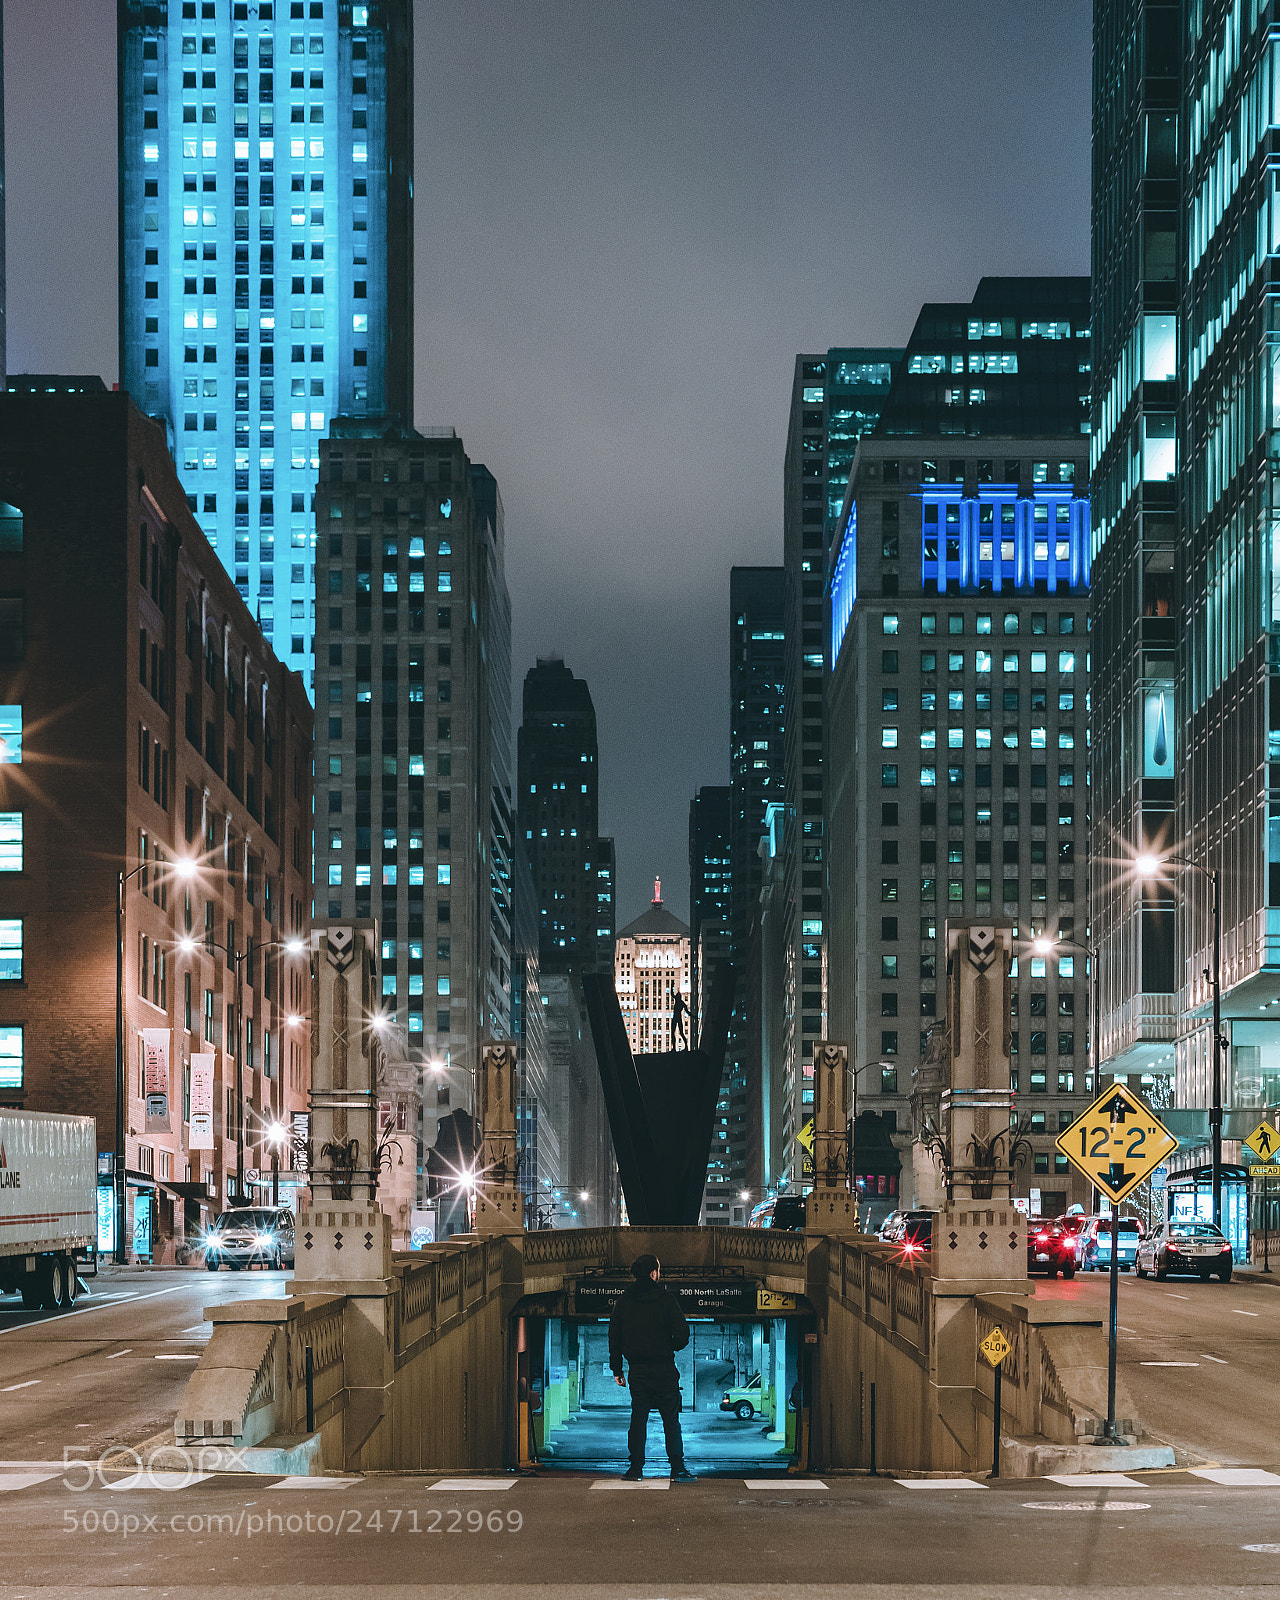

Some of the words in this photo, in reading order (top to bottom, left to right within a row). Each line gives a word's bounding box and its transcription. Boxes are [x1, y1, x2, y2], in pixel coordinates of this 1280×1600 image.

[1079, 1126, 1157, 1159] 12'-2"
[598, 1287, 625, 1295] Murdoc
[679, 1288, 693, 1296] 300
[694, 1288, 714, 1296] North
[715, 1288, 742, 1296] LaSalle
[698, 1299, 724, 1307] Garage
[984, 1341, 1008, 1352] SLOW
